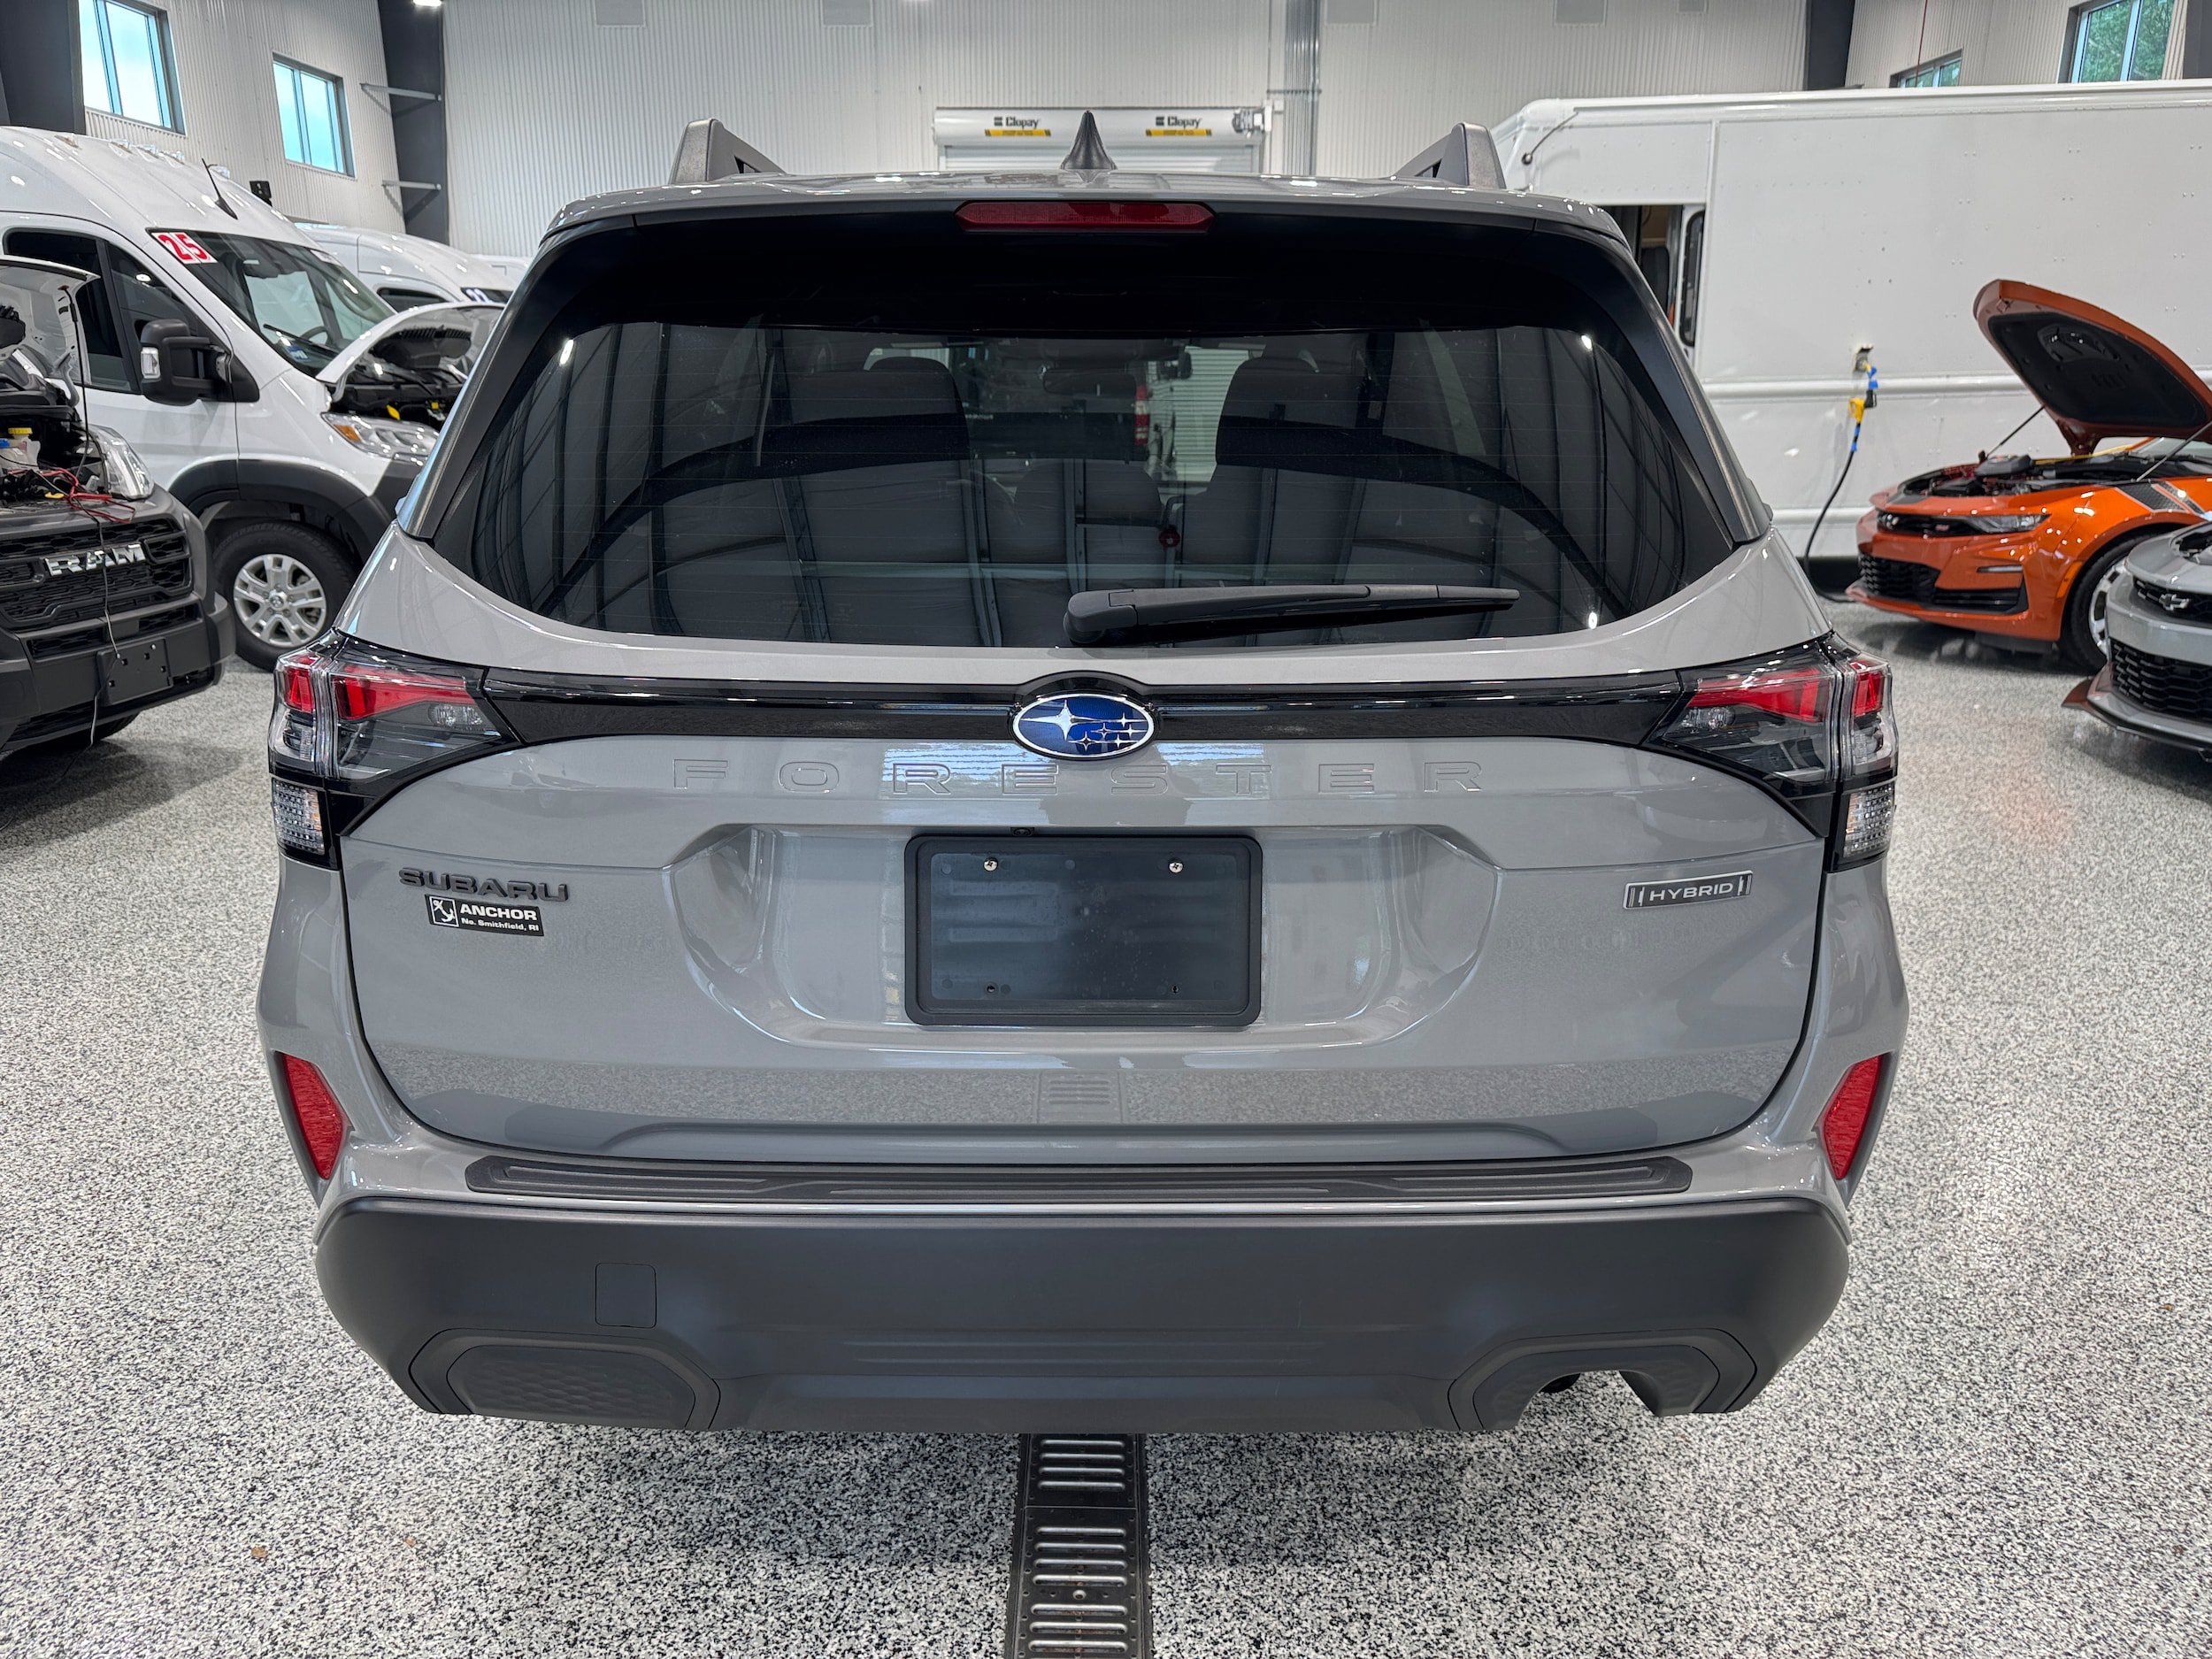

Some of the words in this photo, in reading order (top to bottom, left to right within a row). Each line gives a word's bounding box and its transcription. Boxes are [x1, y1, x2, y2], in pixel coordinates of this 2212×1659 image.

[1005, 116, 1039, 130] Clopay
[1167, 116, 1201, 130] Clopay
[157, 234, 208, 260] 25
[44, 543, 146, 577] RAM
[672, 758, 1483, 795] FORESTER
[398, 867, 569, 902] SUBARU
[1648, 882, 1733, 902] HYBRID
[460, 903, 538, 921] ANCHOR
[461, 918, 477, 926] No.
[478, 919, 527, 931] Smithfield,
